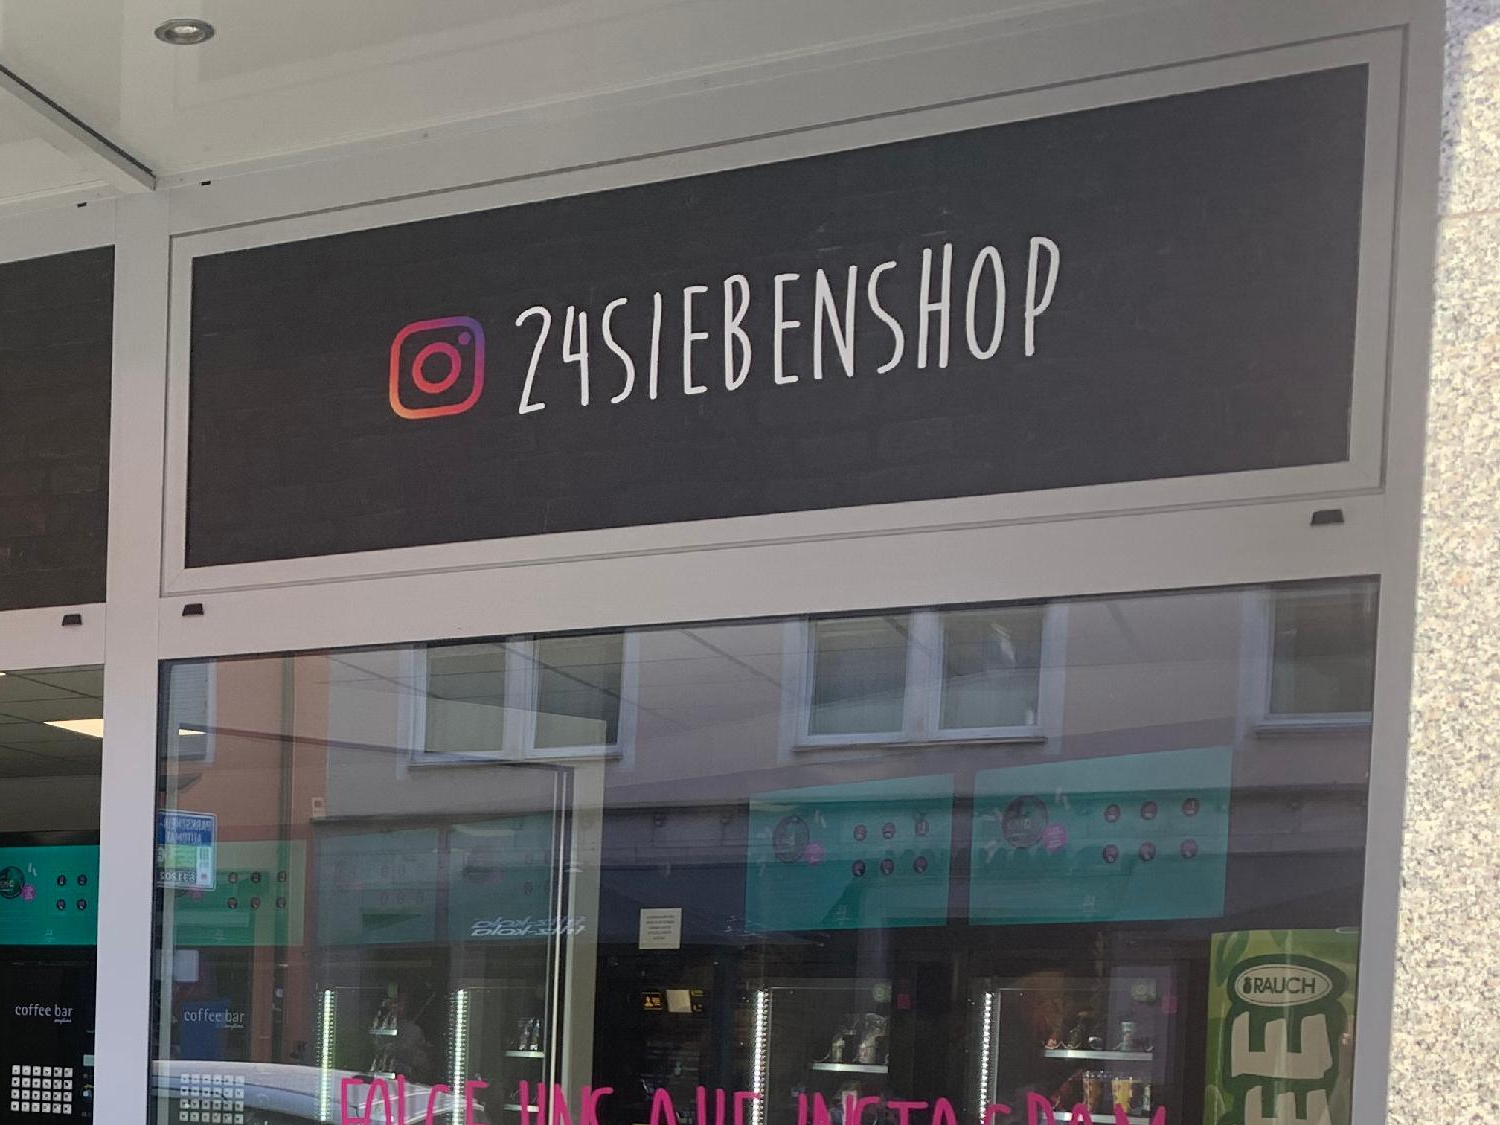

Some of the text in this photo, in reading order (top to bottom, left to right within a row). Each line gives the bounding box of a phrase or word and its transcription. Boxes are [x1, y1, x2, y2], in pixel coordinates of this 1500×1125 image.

[514, 236, 1060, 415] 24SIEBENSHOP
[1253, 977, 1316, 995] RAUCH
[15, 1003, 74, 1018] coffee bar
[184, 1008, 245, 1023] coffee bar
